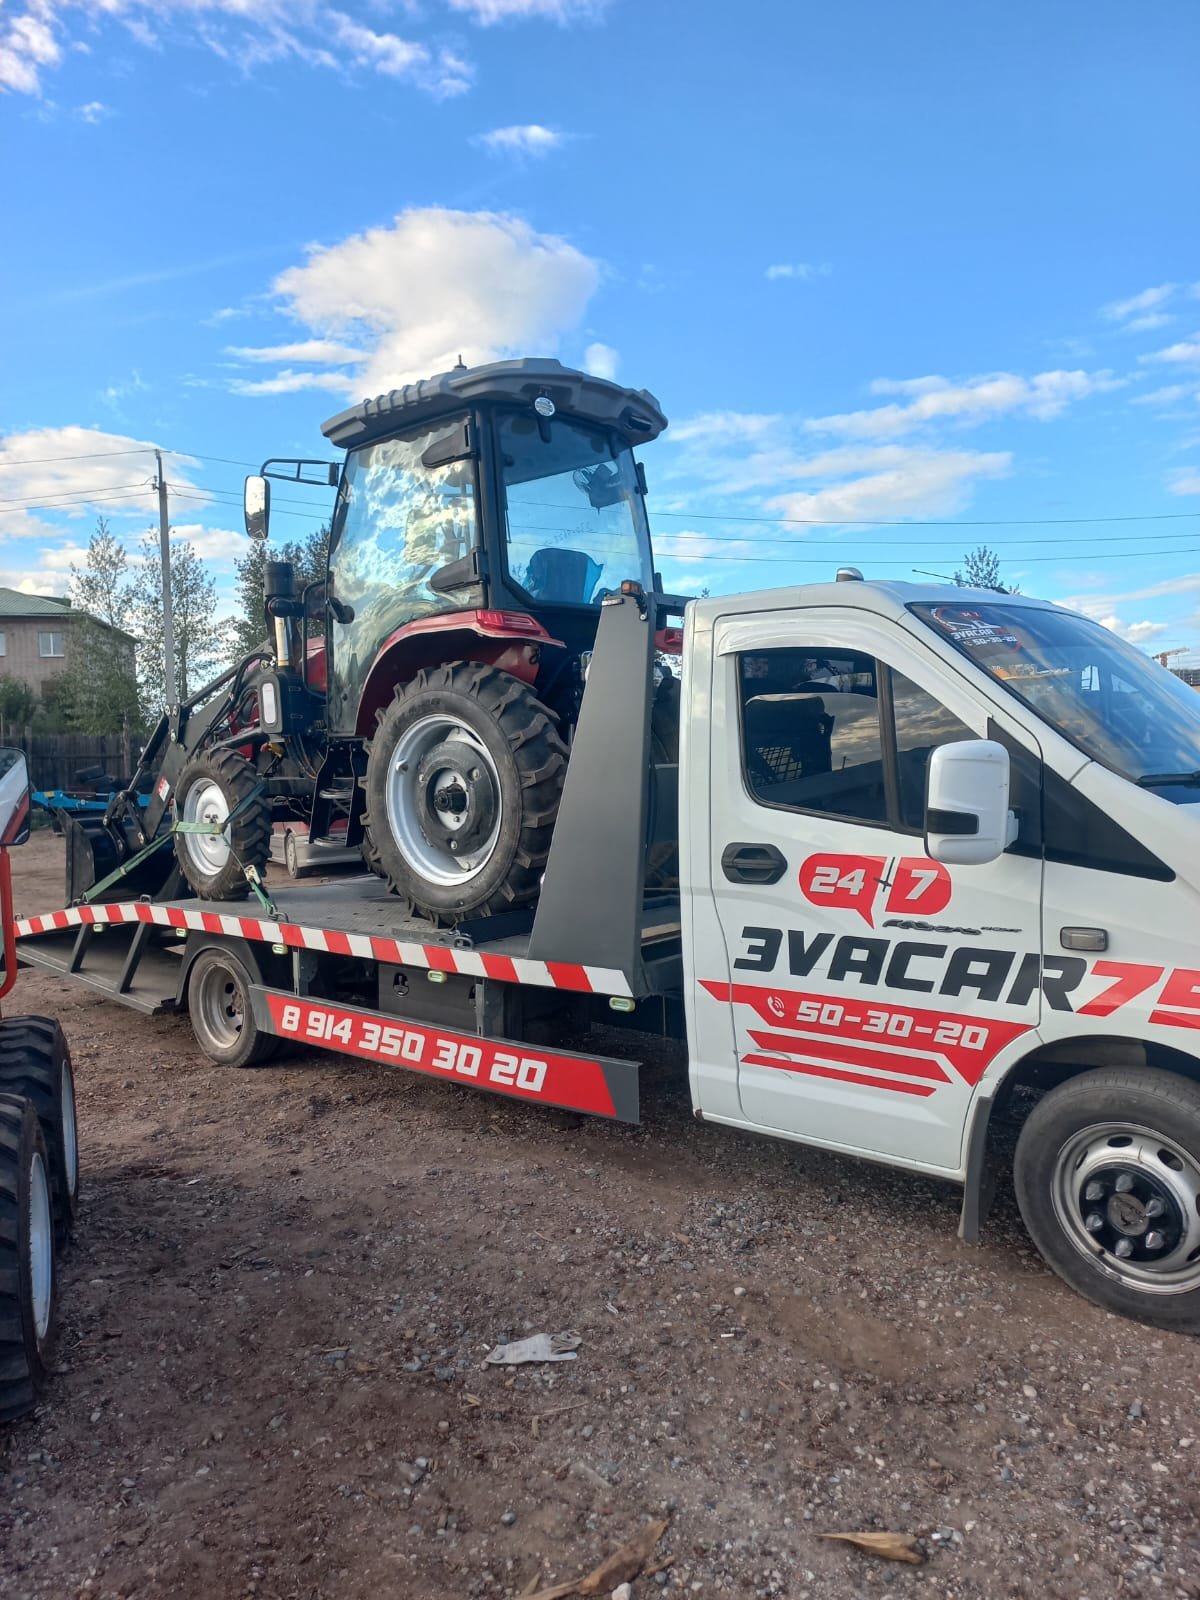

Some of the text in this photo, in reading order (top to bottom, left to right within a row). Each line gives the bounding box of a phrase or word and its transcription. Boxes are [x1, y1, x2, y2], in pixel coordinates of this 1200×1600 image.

[281, 1004, 548, 1092] 8 914 350 30 20
[796, 1000, 990, 1051] 50-30-20
